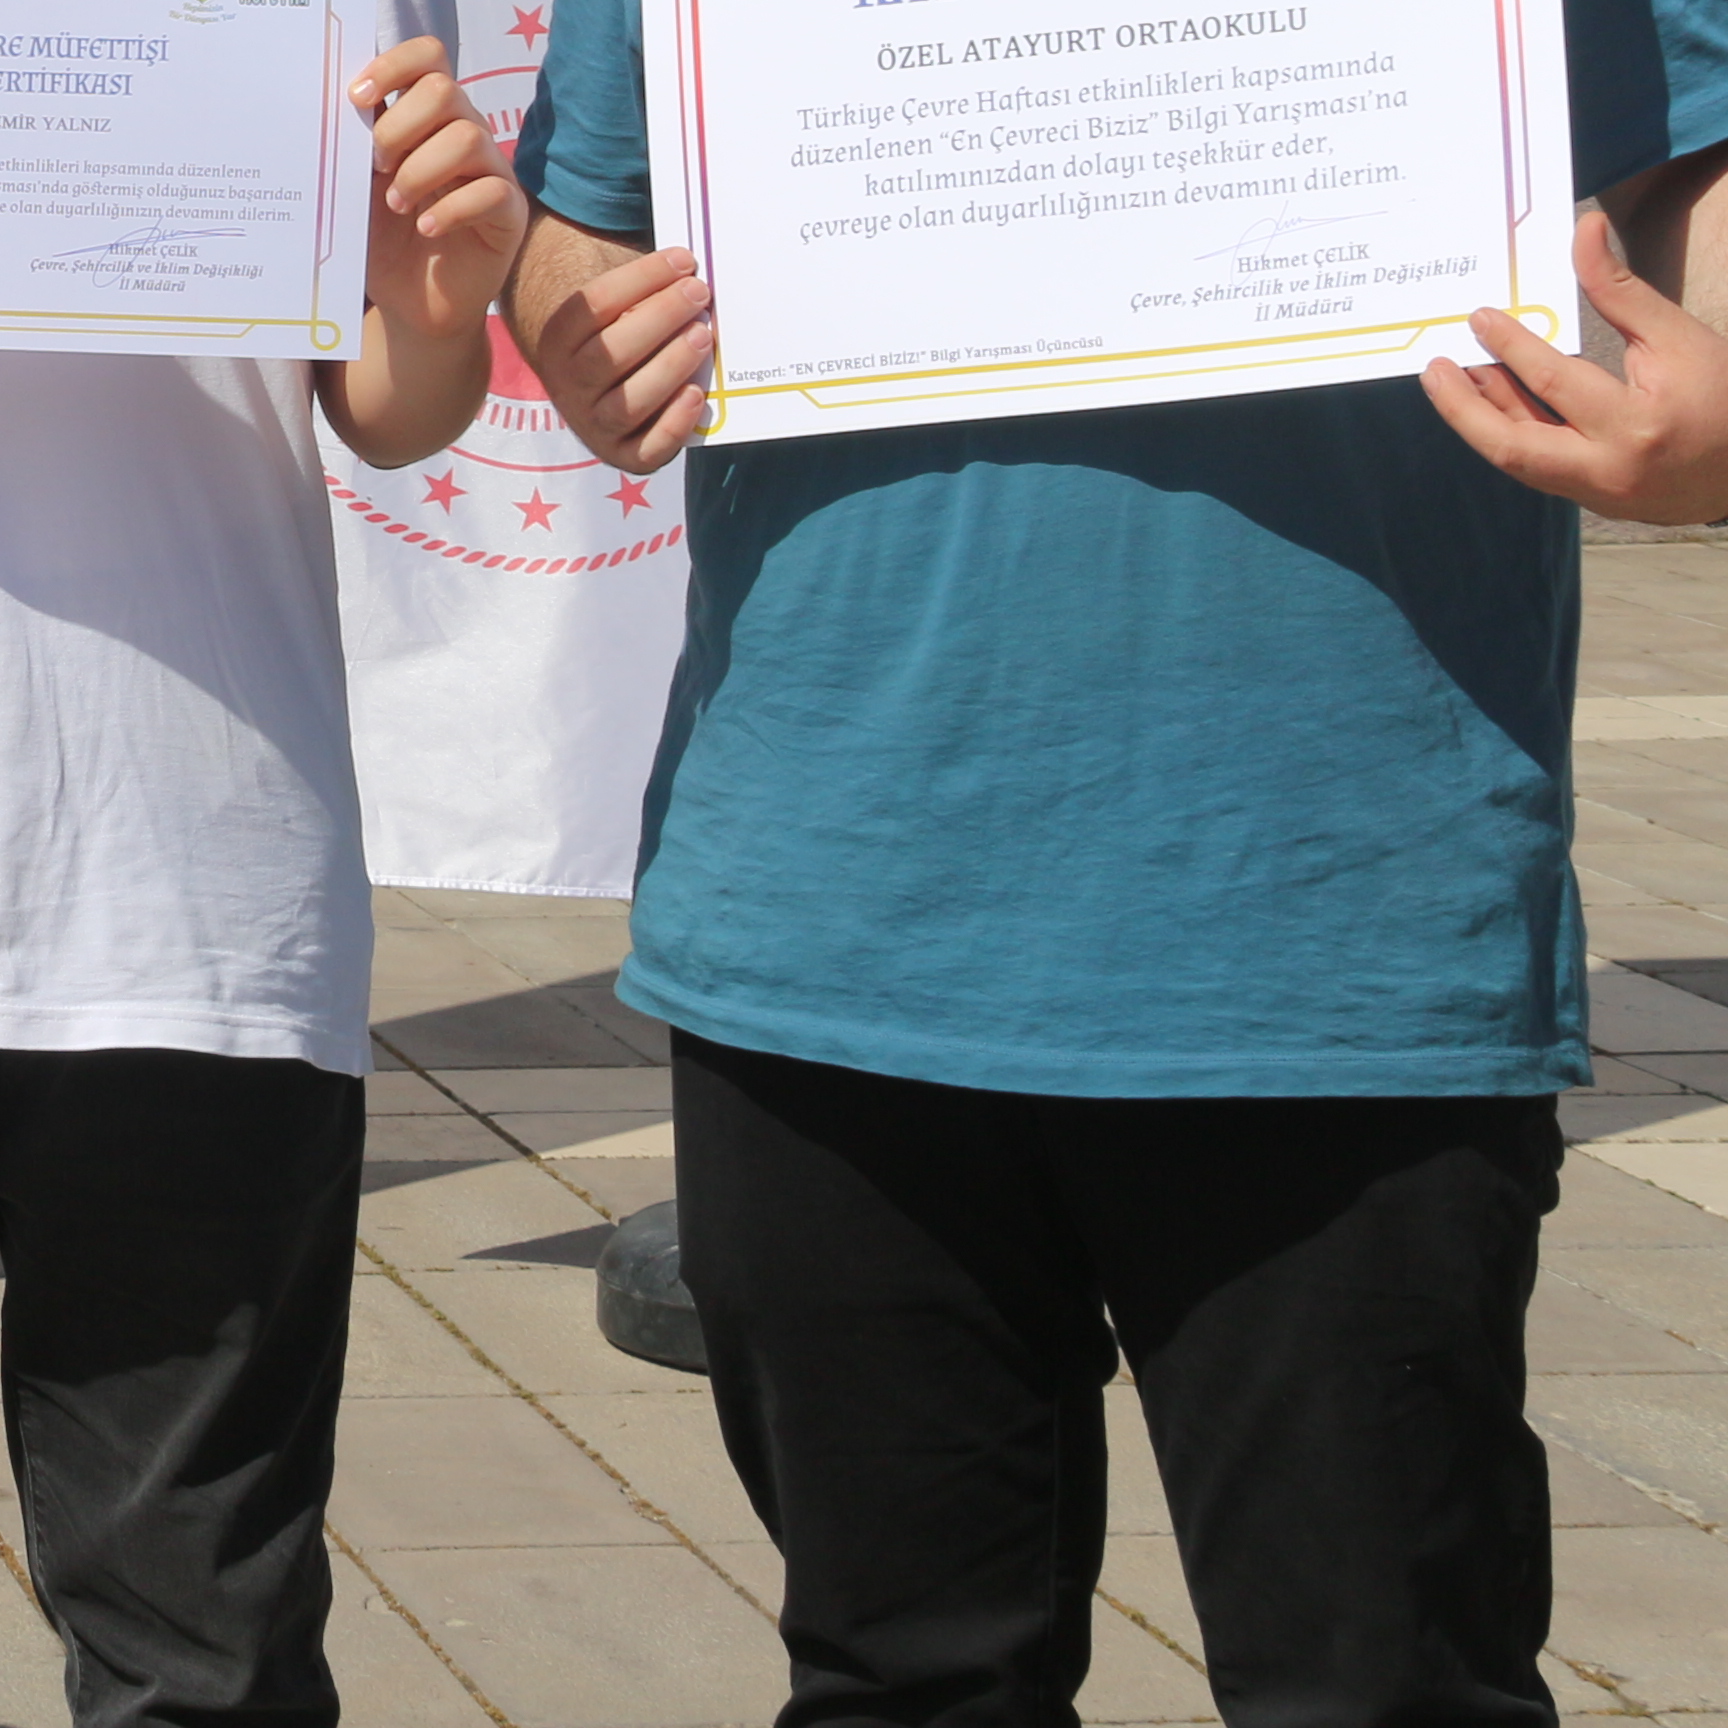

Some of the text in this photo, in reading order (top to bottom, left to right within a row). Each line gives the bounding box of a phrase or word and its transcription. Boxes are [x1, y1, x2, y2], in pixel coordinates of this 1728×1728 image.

[26, 31, 169, 67] MÜFETTİŞİ
[876, 6, 1306, 71] ÖZEL ATAYURT ORTAOKULU
[795, 50, 1394, 130] Türkiye Çevre Haftası etkinlikleri kapsamında
[41, 116, 111, 132] YALNIZ
[790, 136, 932, 167] düzenlenen
[989, 123, 1079, 153] Çevreci
[1166, 105, 1227, 132] Bilgi
[82, 159, 174, 178] kapsamında
[176, 162, 260, 179] düzenlenen
[864, 132, 1335, 196] katılımınızdan dolayı teşekkür eder,
[799, 164, 1406, 245] çevreye olan duyarlılığınızın devamını dilerim.
[1129, 255, 1477, 313] Çevre, Şehircilik ve İklim Değişikliği
[1236, 243, 1370, 273] Hikmet ÇELİK
[1274, 298, 1353, 320] Müdürü
[727, 365, 786, 382] Kategori:
[816, 353, 875, 375] ÇEVRECİ
[929, 348, 961, 363] Bilgi
[963, 344, 1032, 359] Yarışması
[1035, 335, 1103, 354] Üçüncüsü
